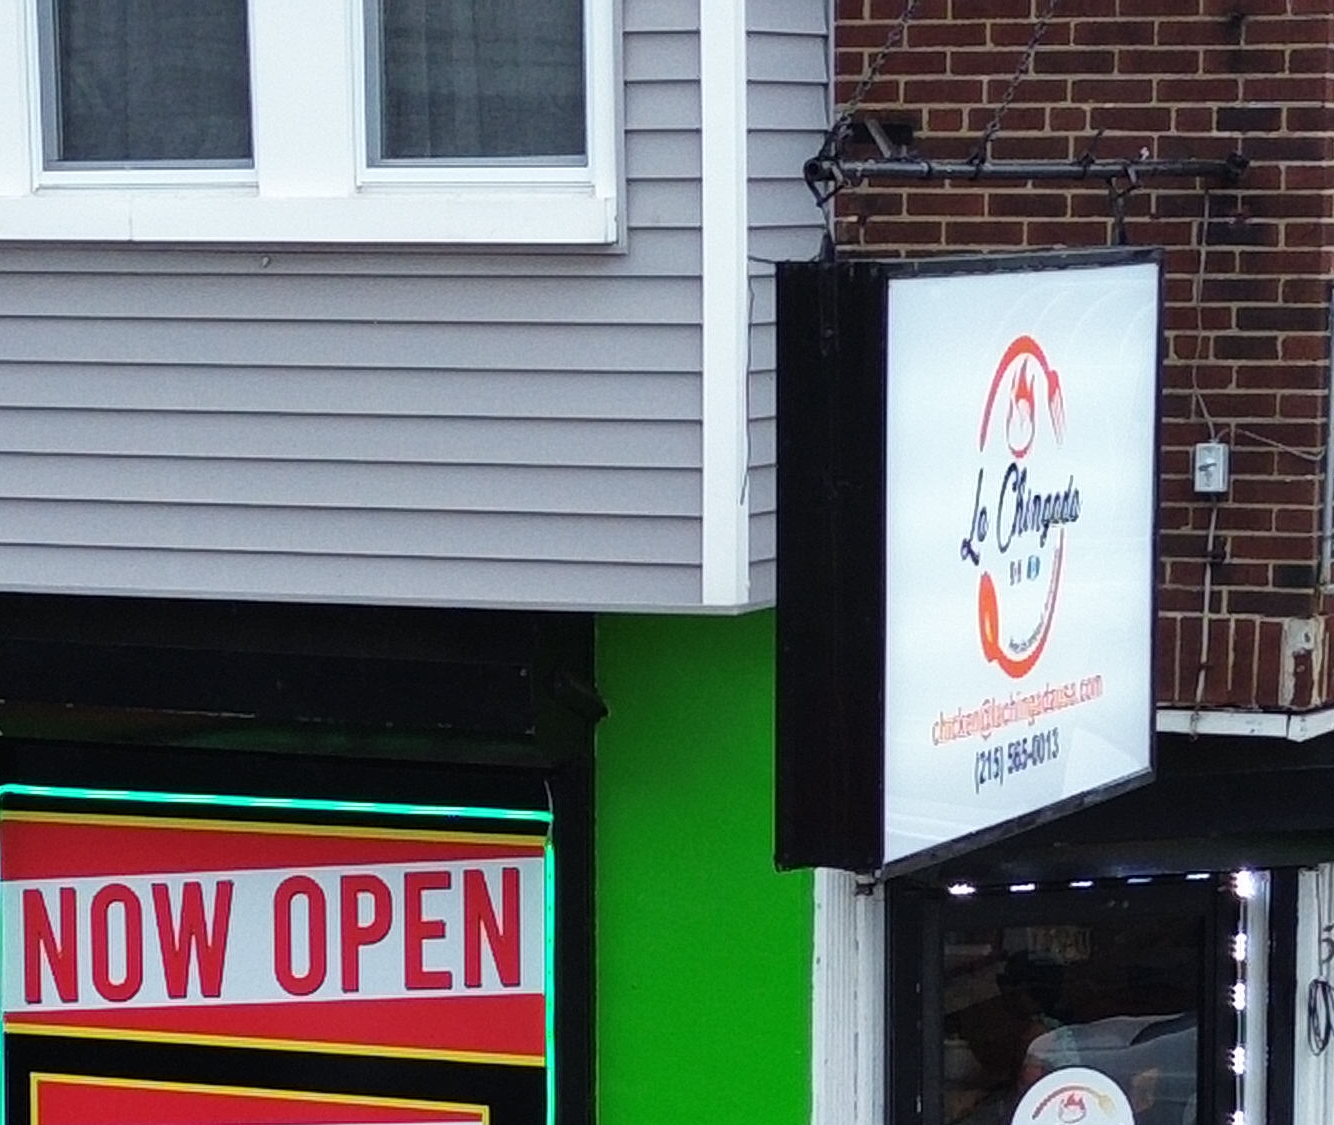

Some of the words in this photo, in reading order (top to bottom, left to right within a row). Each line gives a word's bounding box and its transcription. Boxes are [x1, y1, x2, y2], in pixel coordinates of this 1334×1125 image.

[960, 467, 988, 566] La
[997, 462, 1081, 553] Chingada
[974, 745, 1004, 794] (215)
[1007, 727, 1060, 774] 565-0013
[22, 879, 233, 1004] NOW
[273, 867, 520, 997] OPEN
